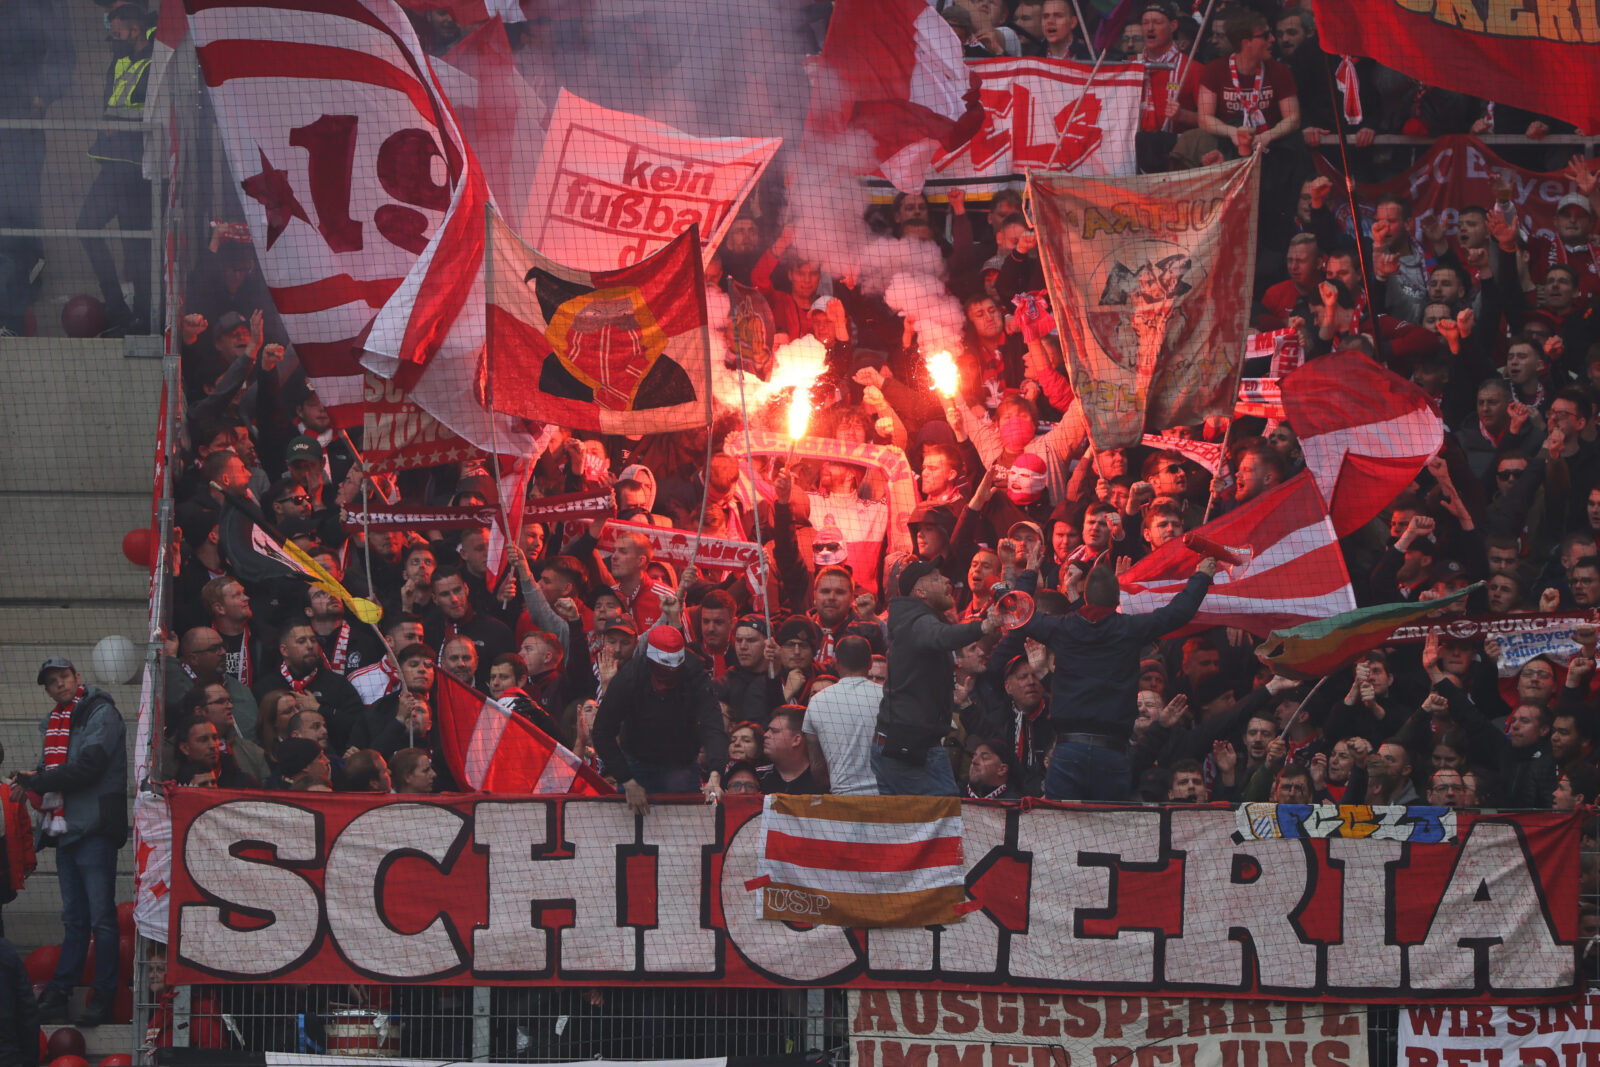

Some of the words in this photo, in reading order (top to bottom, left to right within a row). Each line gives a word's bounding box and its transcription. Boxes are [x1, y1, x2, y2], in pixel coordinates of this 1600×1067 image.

[931, 83, 1103, 173] ELS
[622, 143, 715, 196] kein
[1409, 148, 1454, 199] FC
[766, 887, 831, 917] USP
[853, 990, 1361, 1039] AUSGESPERRTE
[1407, 1005, 1496, 1038] WIR
[1507, 995, 1600, 1037] SIN
